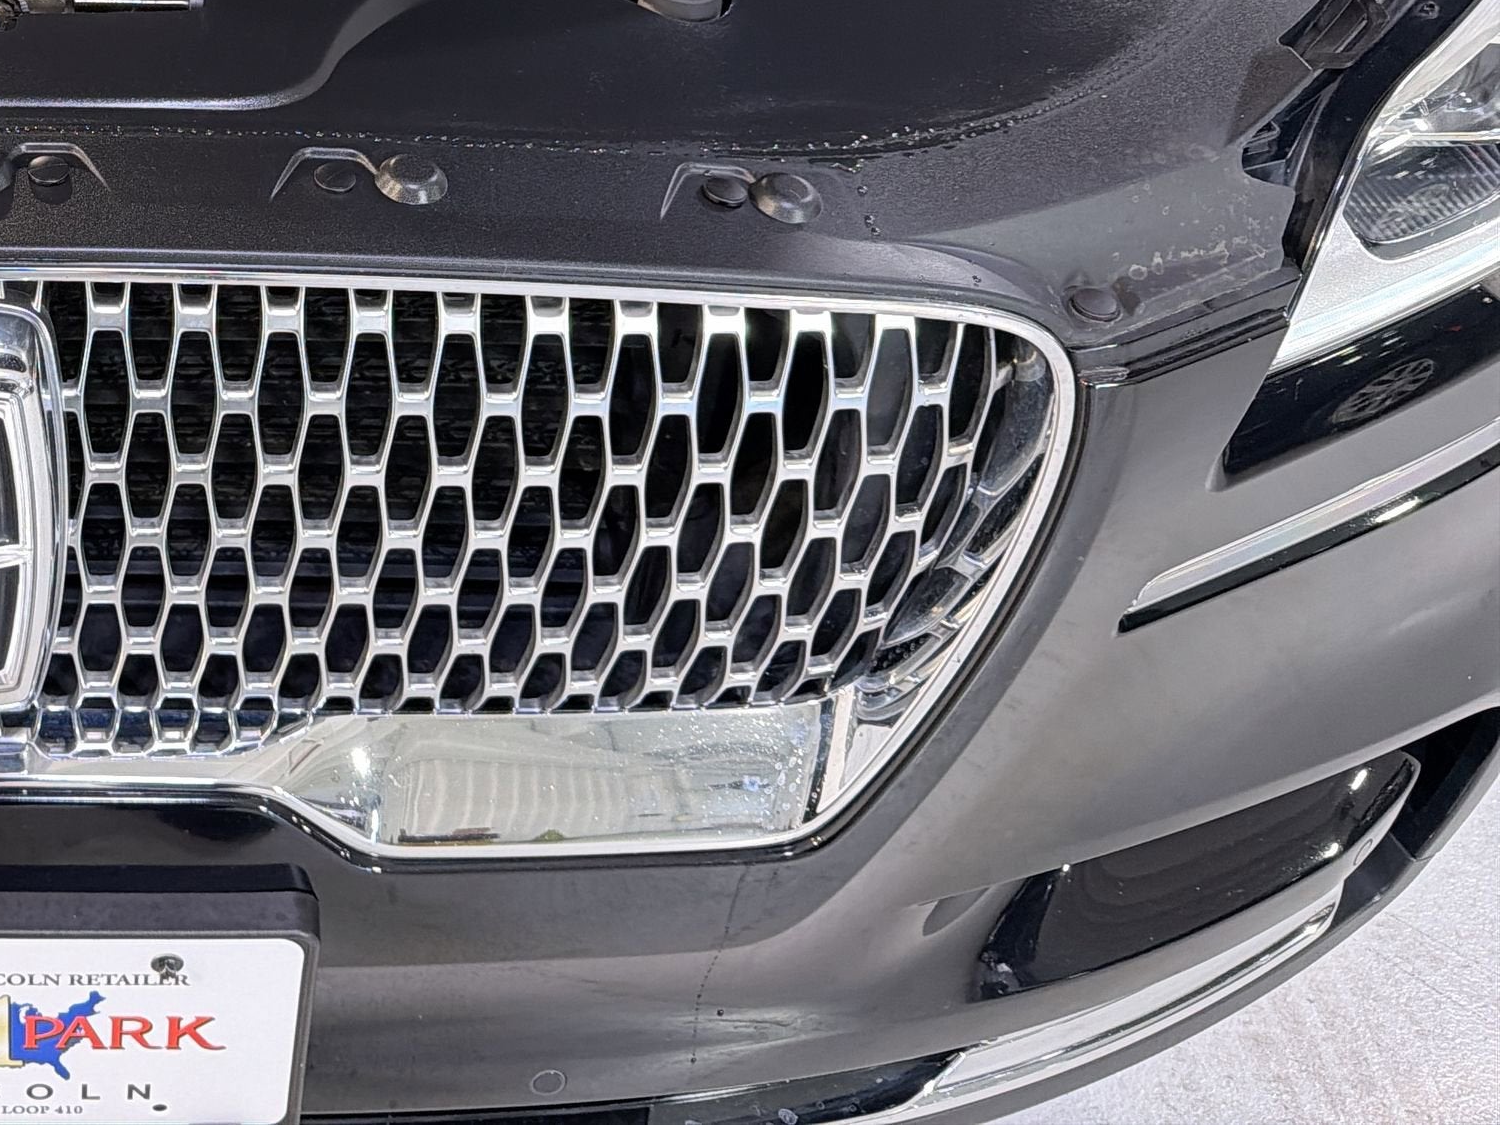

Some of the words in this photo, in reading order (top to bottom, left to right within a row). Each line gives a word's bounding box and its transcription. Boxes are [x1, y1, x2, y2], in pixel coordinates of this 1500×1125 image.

[68, 973, 190, 986] RETAILER
[23, 1015, 227, 1051] PARK
[2, 1105, 51, 1115] LOOP
[54, 1105, 83, 1115] 410
